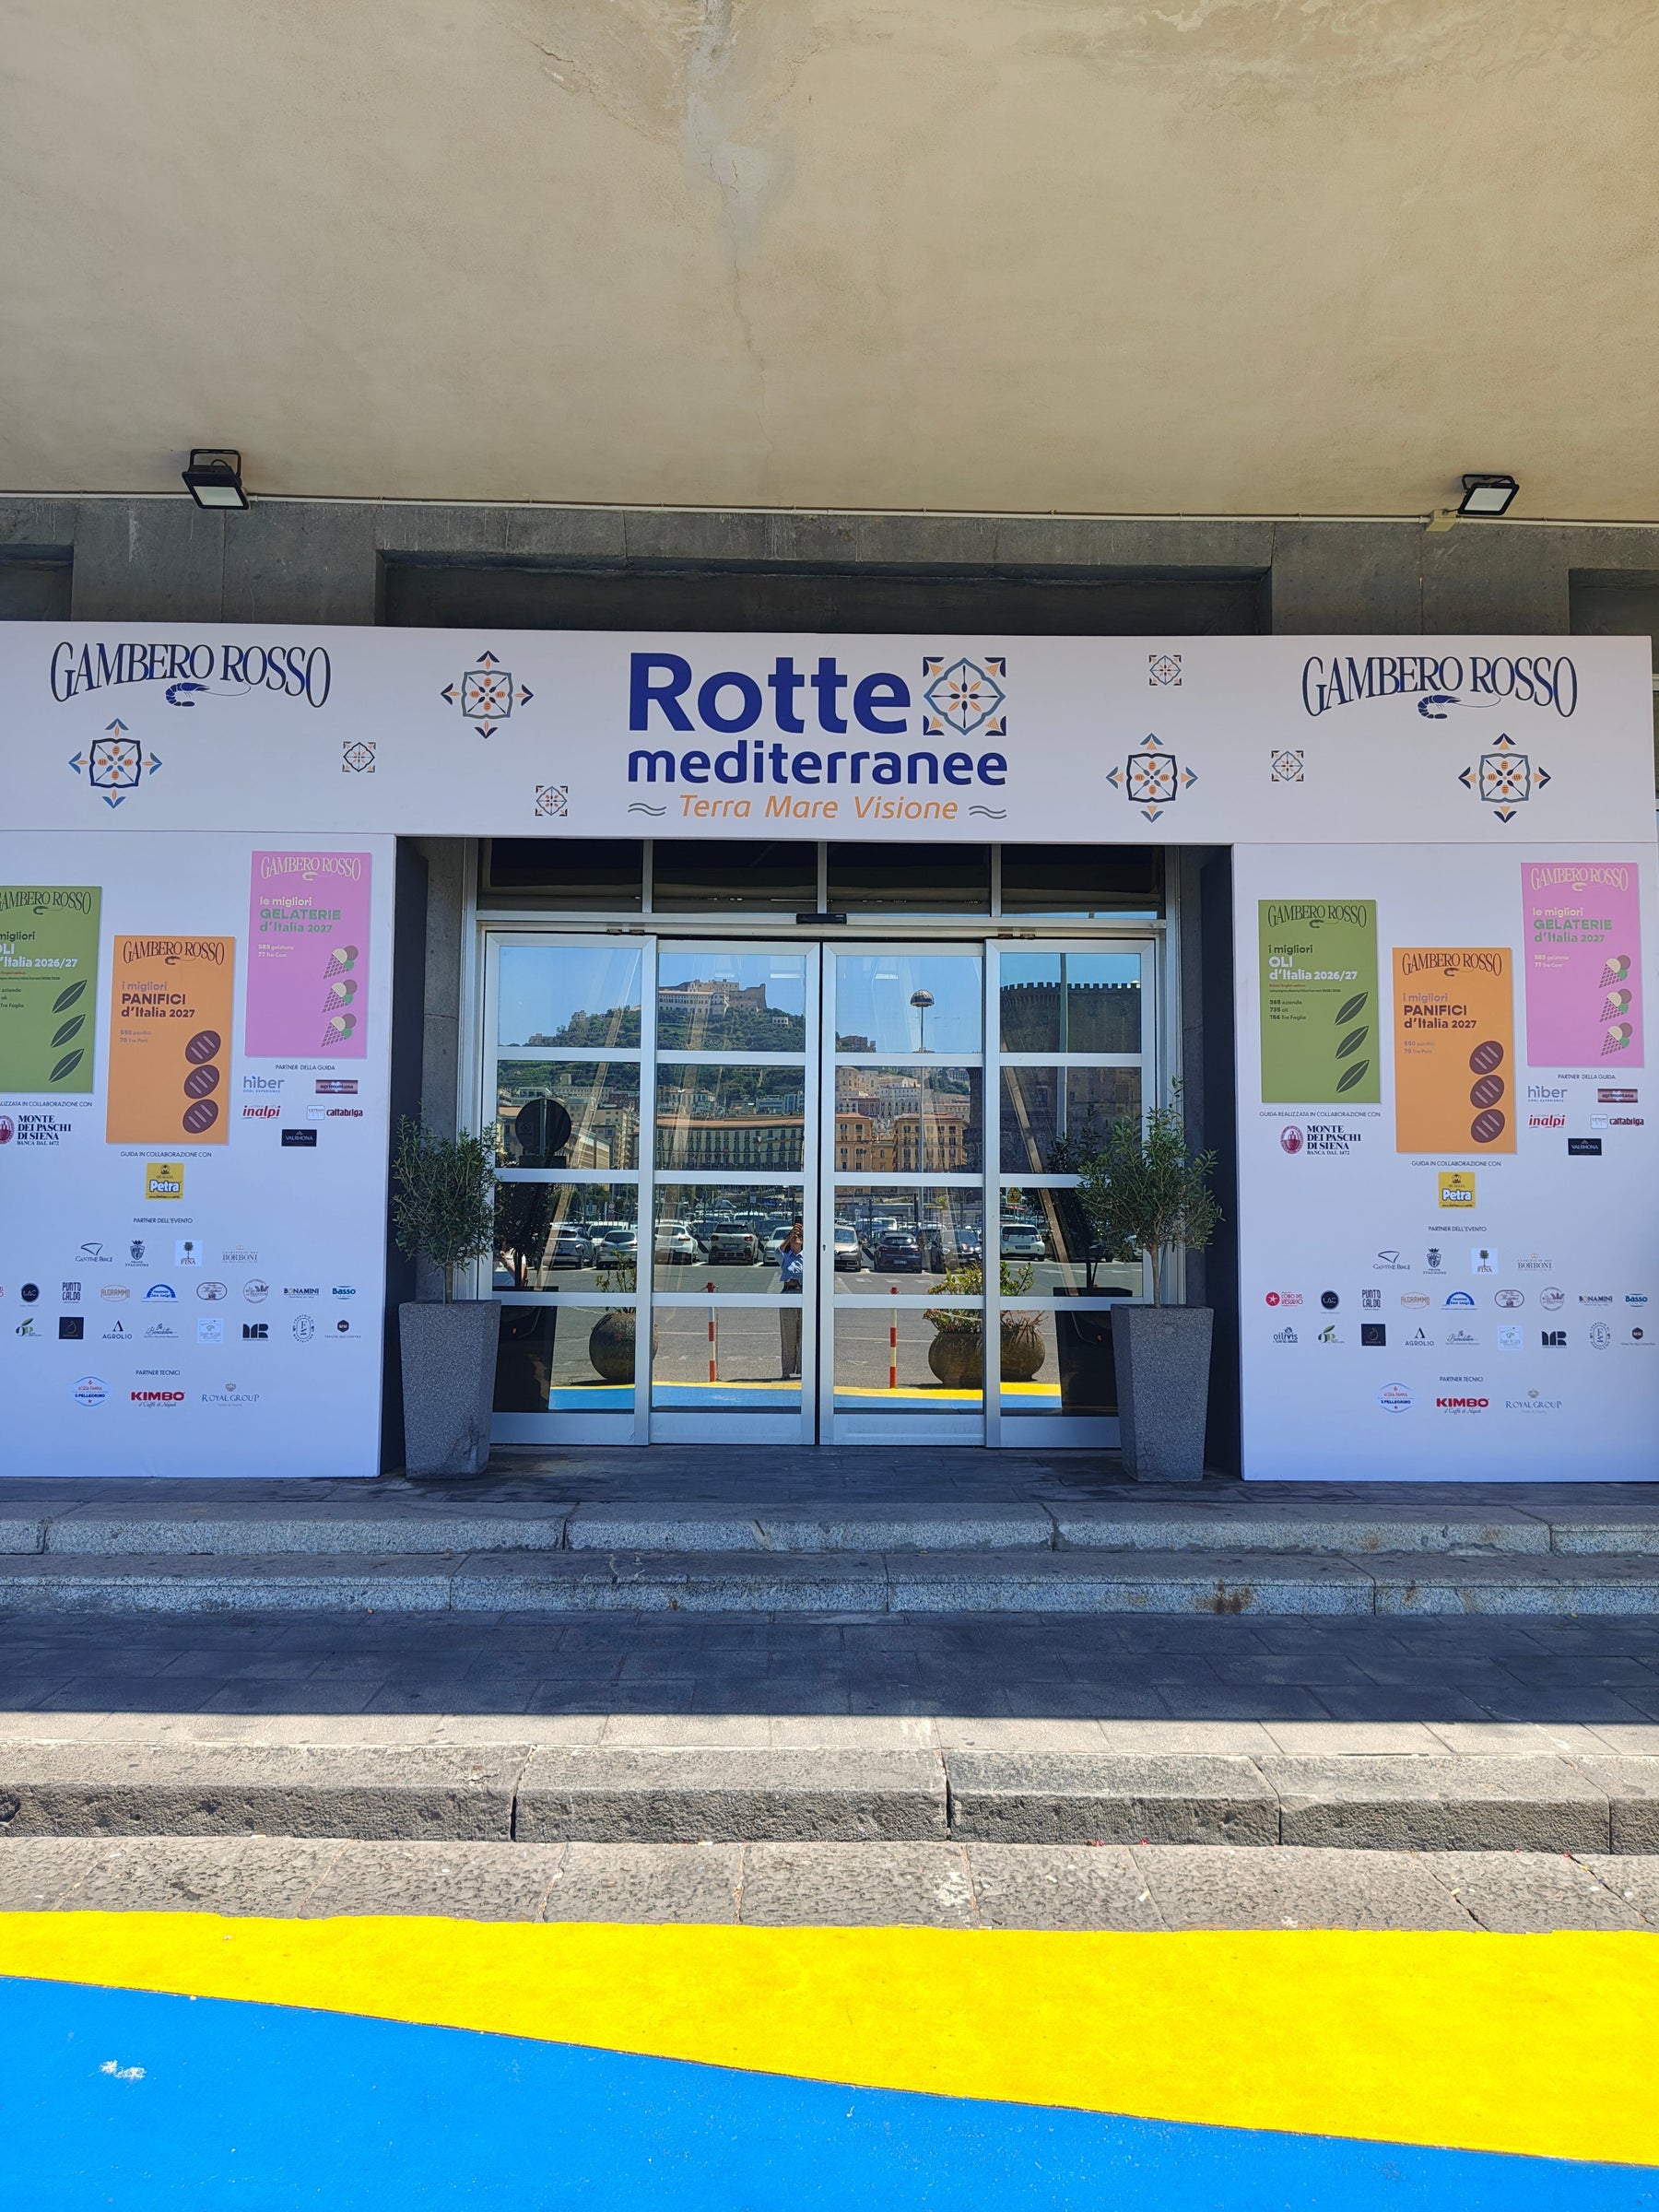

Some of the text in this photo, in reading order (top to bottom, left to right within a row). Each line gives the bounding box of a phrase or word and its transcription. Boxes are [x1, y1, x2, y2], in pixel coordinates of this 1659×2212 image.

[50, 641, 331, 708] GAMBERO ROSSO
[1301, 656, 1578, 718] GAMBERO ROSSO
[629, 653, 911, 735] Rotte
[628, 739, 1007, 785] mediterranee
[679, 794, 959, 819] Terra Mare Visione
[261, 856, 361, 881] GAMBERO ROSSO
[1531, 867, 1629, 891] GAMBERO ROSSO
[0, 891, 91, 914] AMBERO ROSSO
[260, 896, 312, 907] le migliori
[260, 909, 341, 920] GELATERIE
[1268, 905, 1367, 928] GAMBERO ROSSO
[1533, 907, 1583, 918] le migliori
[259, 922, 333, 933] d'Italia 2027
[1534, 919, 1612, 930] GELATERIE
[1535, 932, 1578, 942] d'Italia
[124, 940, 225, 966] GAMBERO ROSSO
[1268, 945, 1312, 955] i migliori
[0, 956, 77, 969] 'Italia 2026/27
[1269, 956, 1293, 968] OLI
[1402, 953, 1502, 976] GAMBERO ROSSO
[1269, 969, 1358, 982] d'Italia 2026/27
[122, 982, 168, 992] i migliori
[122, 994, 186, 1005] PANIFICI
[1403, 993, 1448, 1003] i migliori
[121, 1006, 195, 1018] d'Italia 2027
[1404, 1005, 1467, 1016] PANIFICI
[1404, 1018, 1477, 1029] d'Italia 2027
[242, 1105, 281, 1118] inalpi
[1529, 1114, 1566, 1128] inalpi
[18, 1124, 71, 1132] DEI PASCHI
[18, 1132, 59, 1140] DI SIENA
[149, 1180, 180, 1193] Petra
[1442, 1188, 1473, 1201] Petra
[62, 1282, 81, 1291] PUNTO
[62, 1291, 81, 1300] CALDO
[1361, 1289, 1382, 1299] PUNTO
[1362, 1299, 1381, 1308] CALDO
[131, 1392, 184, 1401] KIMBO
[1436, 1398, 1489, 1407] KIMBO
